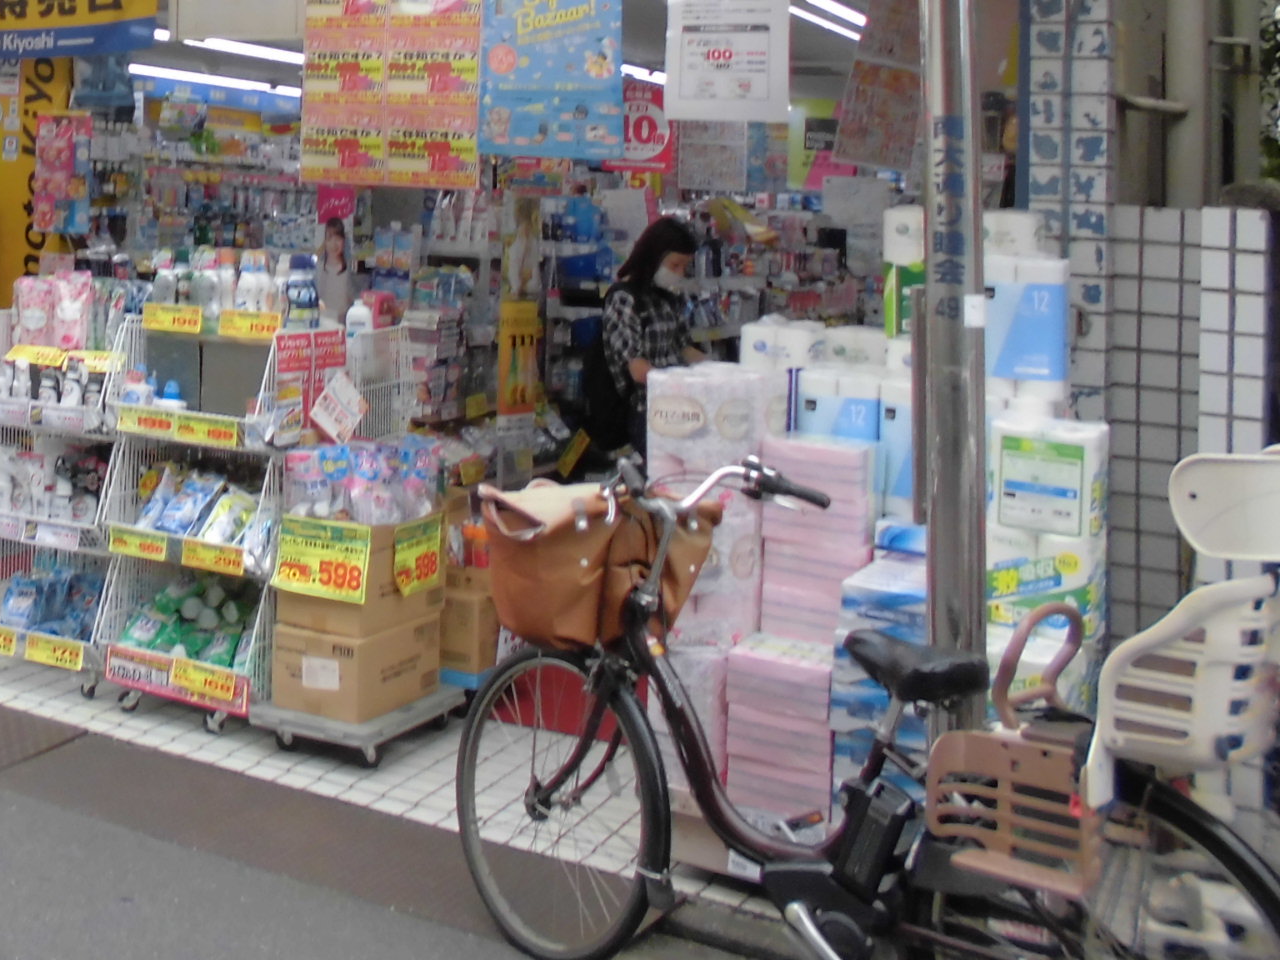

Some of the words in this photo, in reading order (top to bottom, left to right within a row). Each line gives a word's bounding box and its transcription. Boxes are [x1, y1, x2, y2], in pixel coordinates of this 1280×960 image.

[2, 31, 55, 55] Kiyoshi
[1032, 290, 1050, 313] 12
[850, 404, 867, 424] 12
[319, 560, 362, 591] 598
